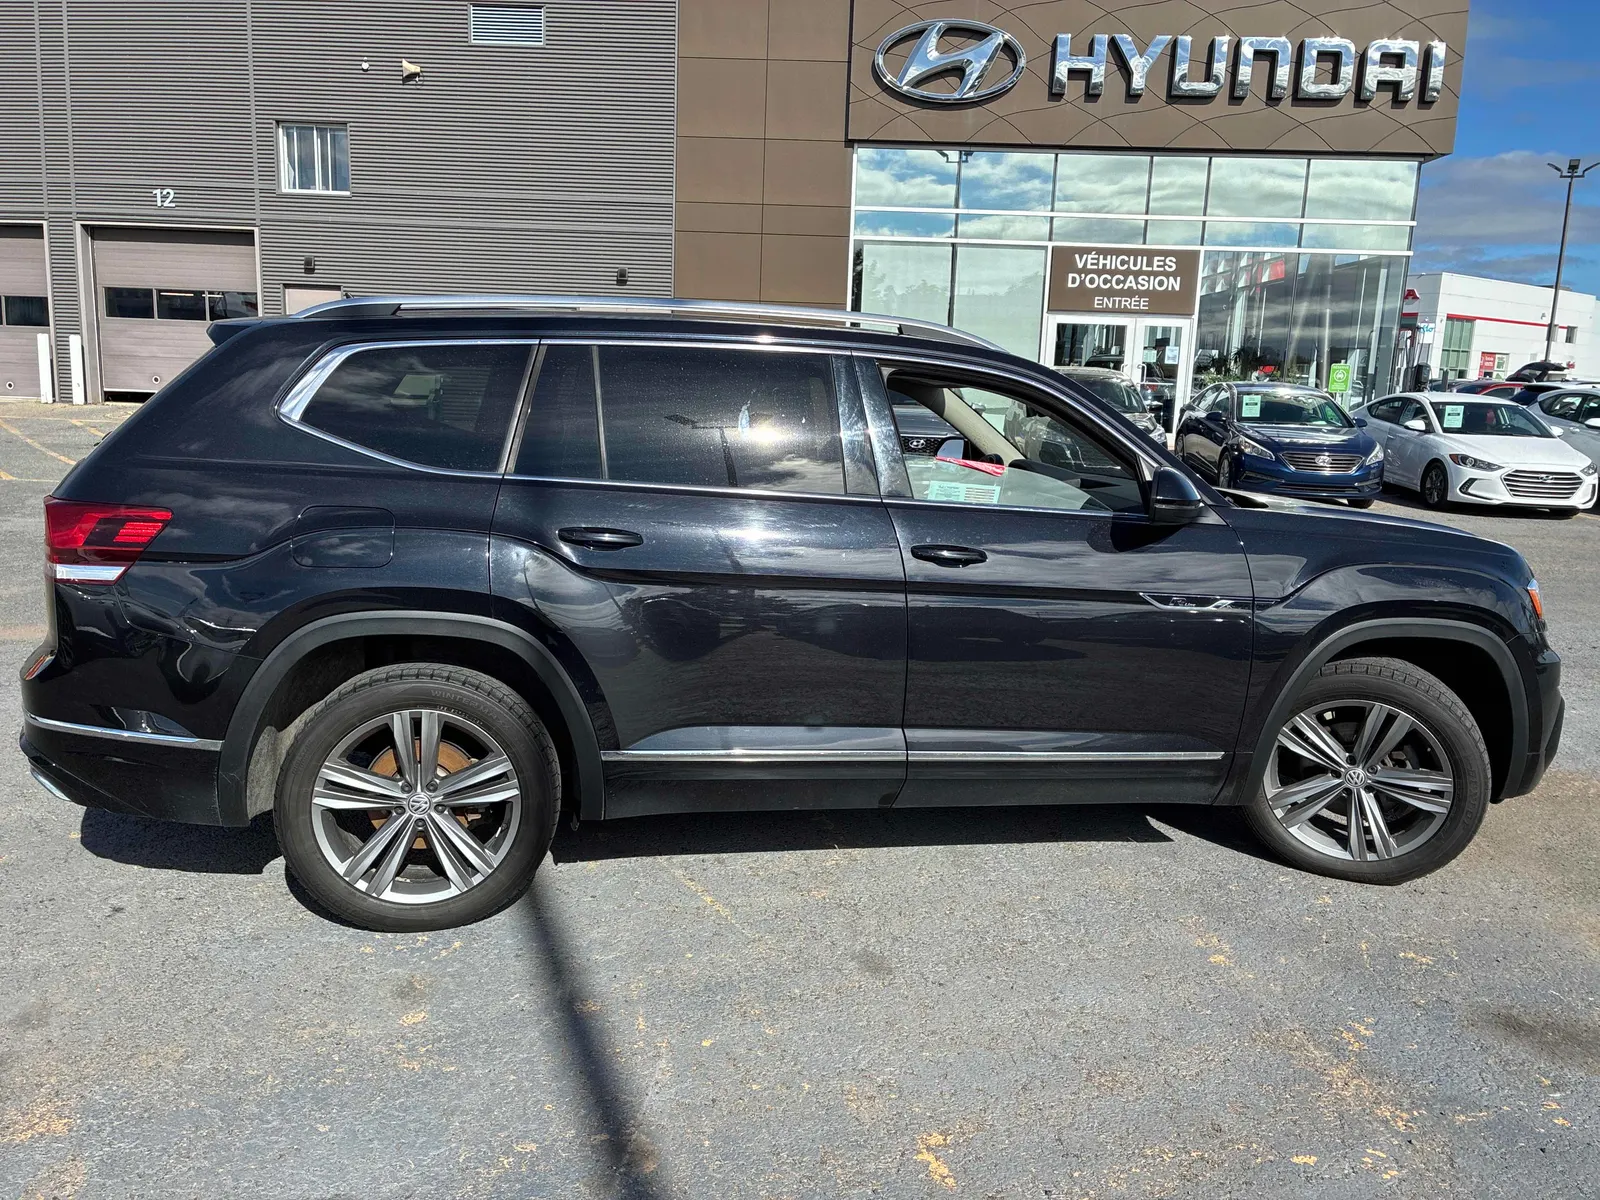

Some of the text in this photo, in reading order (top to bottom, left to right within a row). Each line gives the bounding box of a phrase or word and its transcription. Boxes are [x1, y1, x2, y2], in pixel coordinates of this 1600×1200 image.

[1053, 33, 1447, 102] HYUNDAI
[153, 189, 176, 207] 12
[1075, 251, 1177, 271] VÉHICULES
[1067, 273, 1181, 291] D'OCCASION
[1094, 295, 1149, 309] ENTRÉE
[431, 689, 478, 709] WINTER
